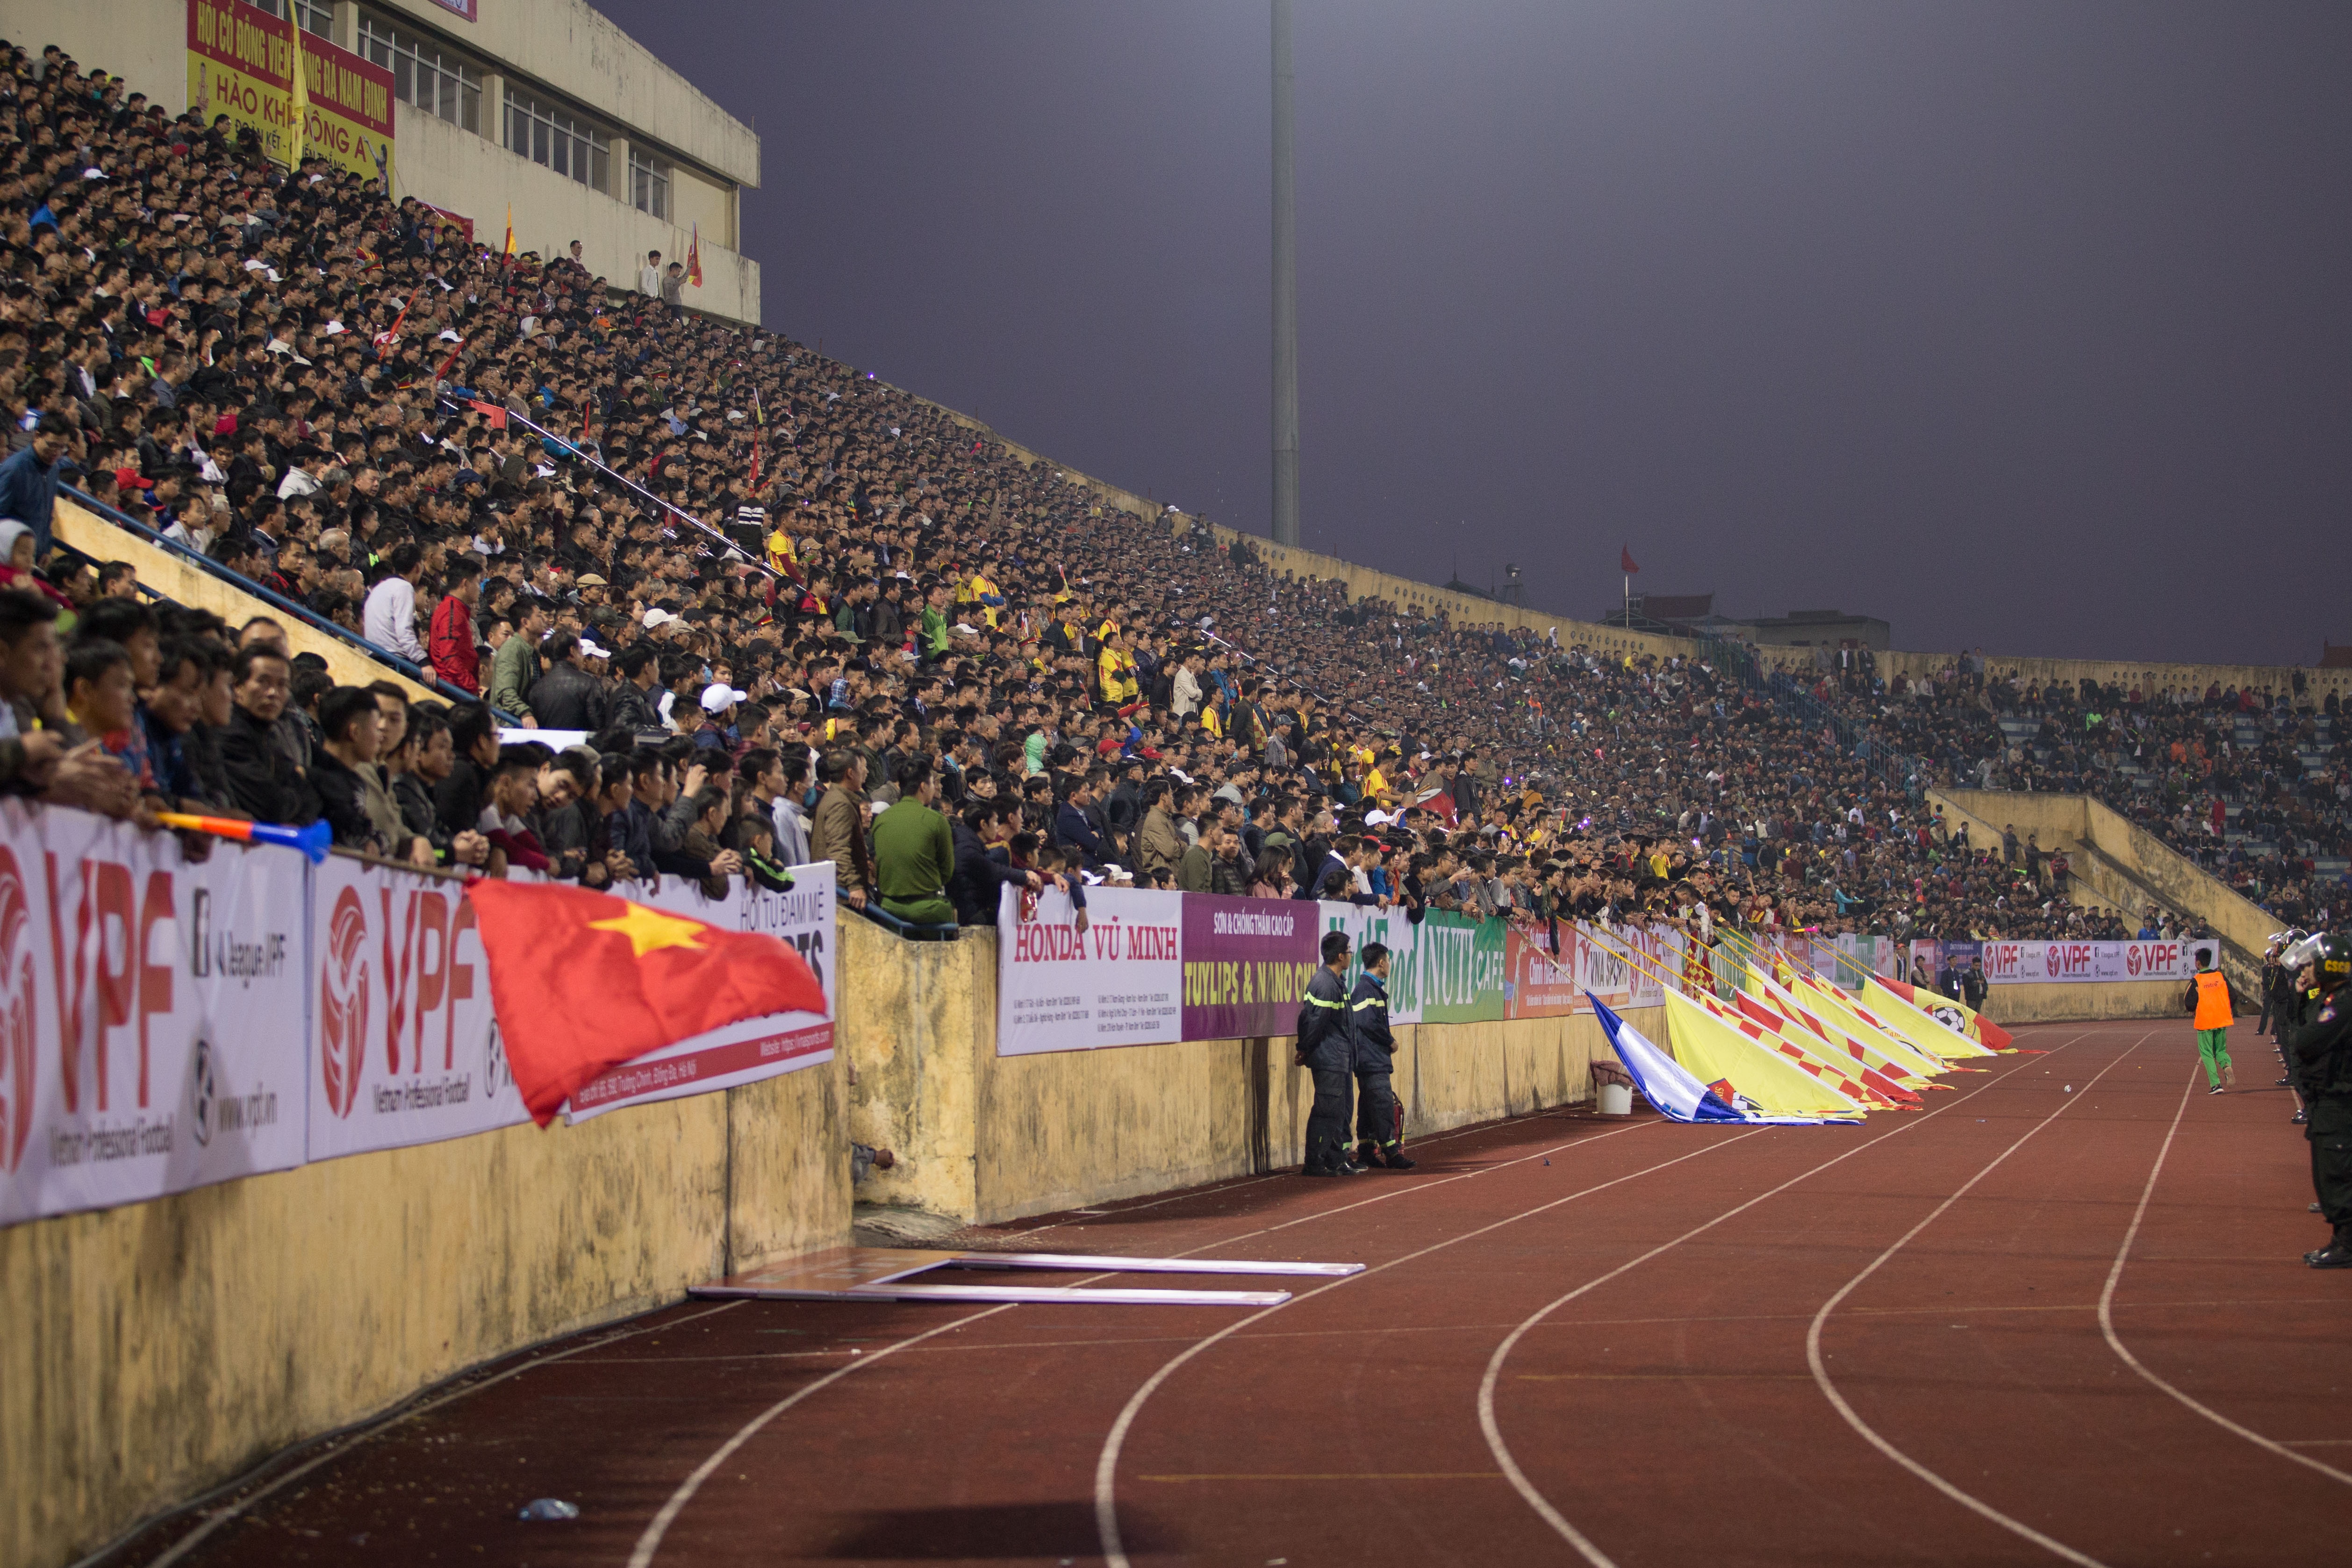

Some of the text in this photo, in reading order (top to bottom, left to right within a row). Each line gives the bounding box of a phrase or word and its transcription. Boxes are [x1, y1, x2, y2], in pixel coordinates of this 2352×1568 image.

[236, 14, 265, 72] ĐỘNG
[268, 29, 292, 81] VIÊN
[302, 41, 321, 94] ÓNG
[323, 54, 337, 102] ĐÁ
[339, 66, 362, 113] NAM
[364, 78, 387, 128] ĐỊNH
[216, 73, 257, 115] HÀO
[354, 136, 366, 162] A
[266, 129, 280, 150] KẾT
[781, 893, 806, 926] ĐAM
[809, 882, 824, 923] MÊ
[1214, 906, 1294, 936] SƠN & CHỐNG THẤM CAO CẤP
[1014, 915, 1177, 962] HONDA VŨ MINH
[1995, 945, 2017, 974] VPF
[2062, 945, 2090, 972] VPF
[2144, 945, 2177, 971] VPF
[44, 848, 173, 1114] VPF
[380, 887, 476, 1075] VPF
[1184, 960, 1239, 1007] TUYLIPS
[1243, 960, 1253, 1004] &
[1257, 961, 1292, 1003] NANO
[1425, 925, 1476, 1006] NUTI
[1529, 957, 1543, 986] Chính
[1590, 951, 1604, 988] VNA
